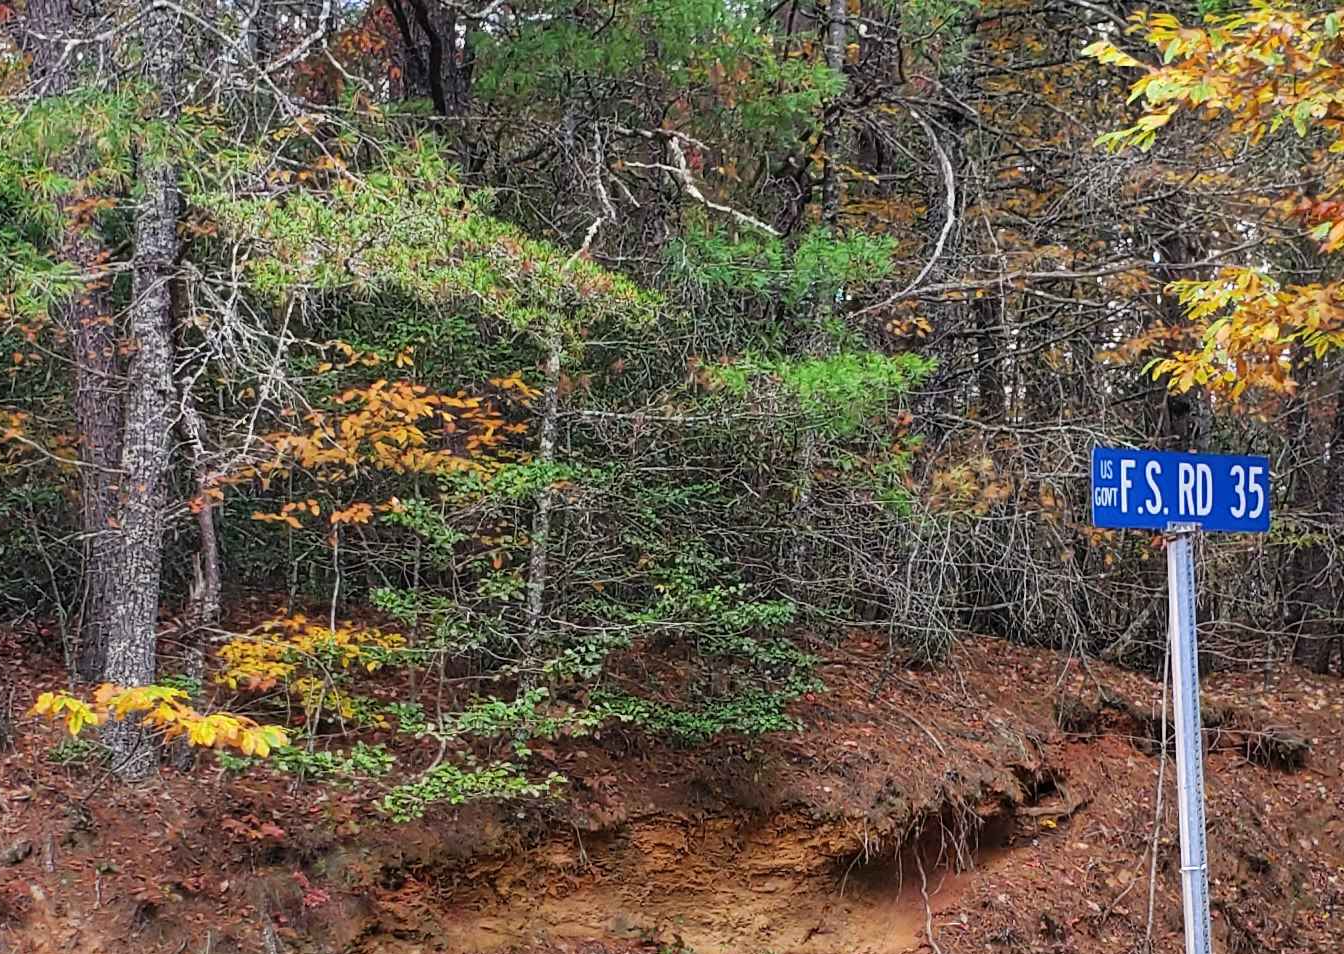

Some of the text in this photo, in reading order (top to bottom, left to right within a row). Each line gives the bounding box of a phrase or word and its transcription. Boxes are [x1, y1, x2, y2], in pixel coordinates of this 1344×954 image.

[1100, 460, 1113, 480] US
[1095, 487, 1118, 507] GOVT
[1120, 459, 1264, 518] F.S. RD 35
